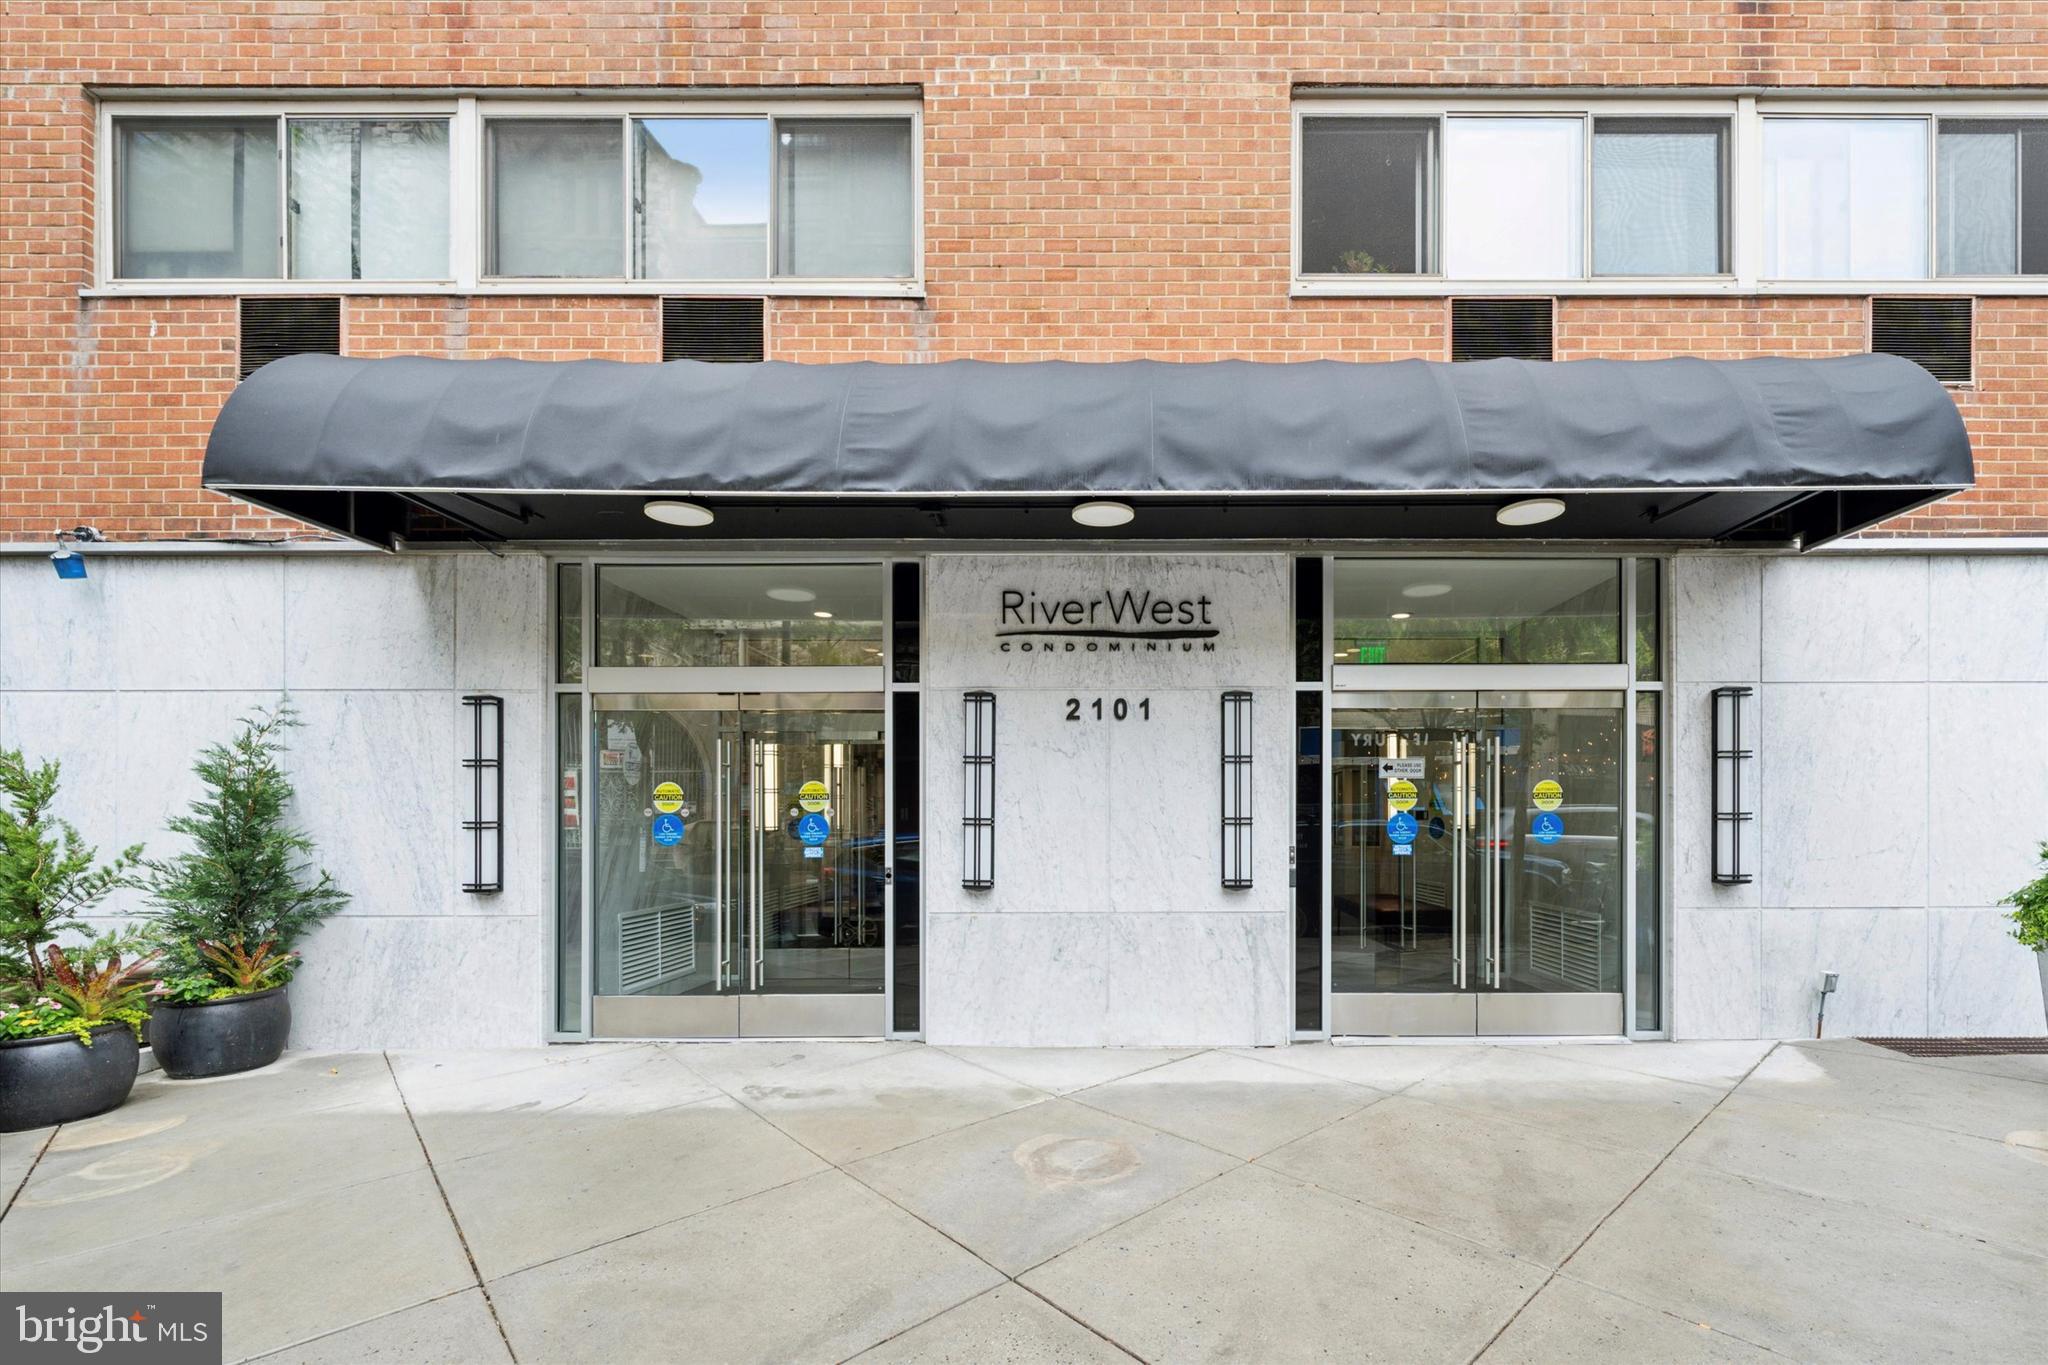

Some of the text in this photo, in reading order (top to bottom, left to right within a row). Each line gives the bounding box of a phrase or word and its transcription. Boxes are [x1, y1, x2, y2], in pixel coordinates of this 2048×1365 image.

[1001, 590, 1212, 625] RiverWest
[1000, 642, 1216, 652] CONDOMINIUM
[1065, 698, 1151, 721] 2101
